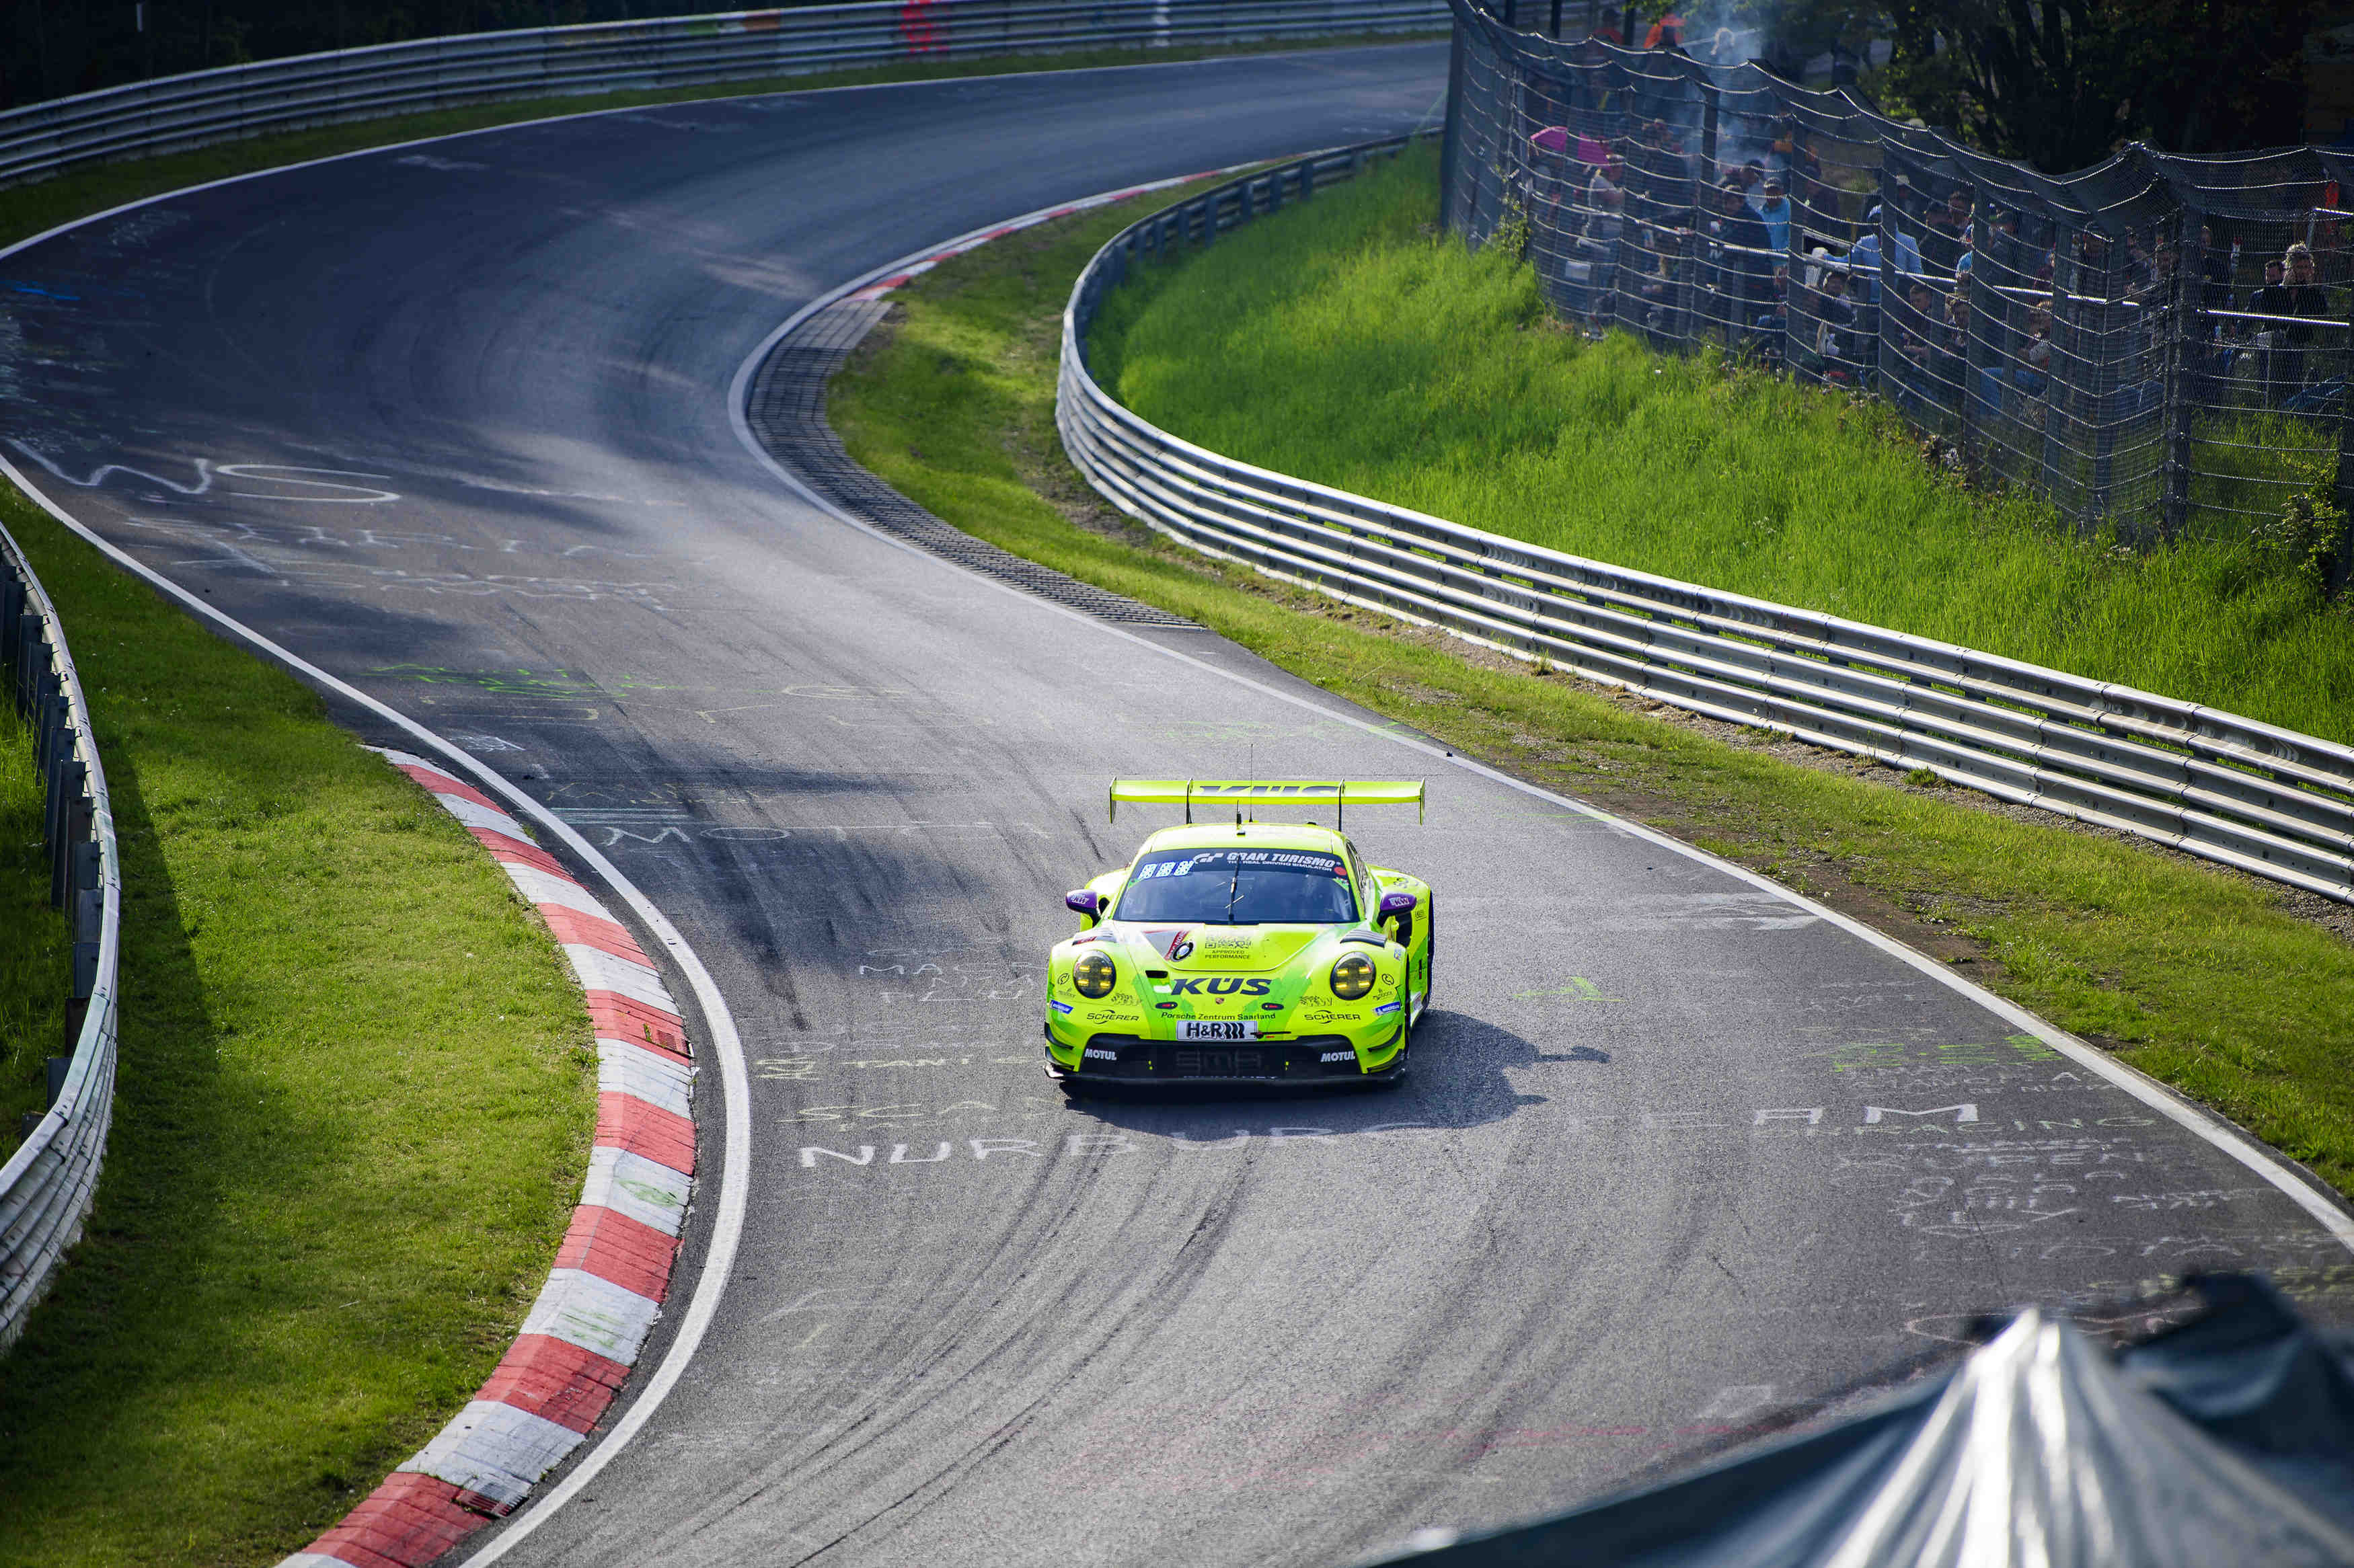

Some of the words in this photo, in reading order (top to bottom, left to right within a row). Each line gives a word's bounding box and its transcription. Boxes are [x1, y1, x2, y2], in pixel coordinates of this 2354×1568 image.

[1226, 852, 1269, 861] GRAN
[1271, 853, 1336, 868] TURISMO
[1171, 978, 1272, 996] KÜS
[1087, 1011, 1139, 1022] SCHERER
[1161, 1011, 1197, 1020] Porsche
[1304, 1011, 1361, 1022] SCHERER
[1084, 1048, 1117, 1060] MOTUL
[1320, 1050, 1355, 1062] MOTUL
